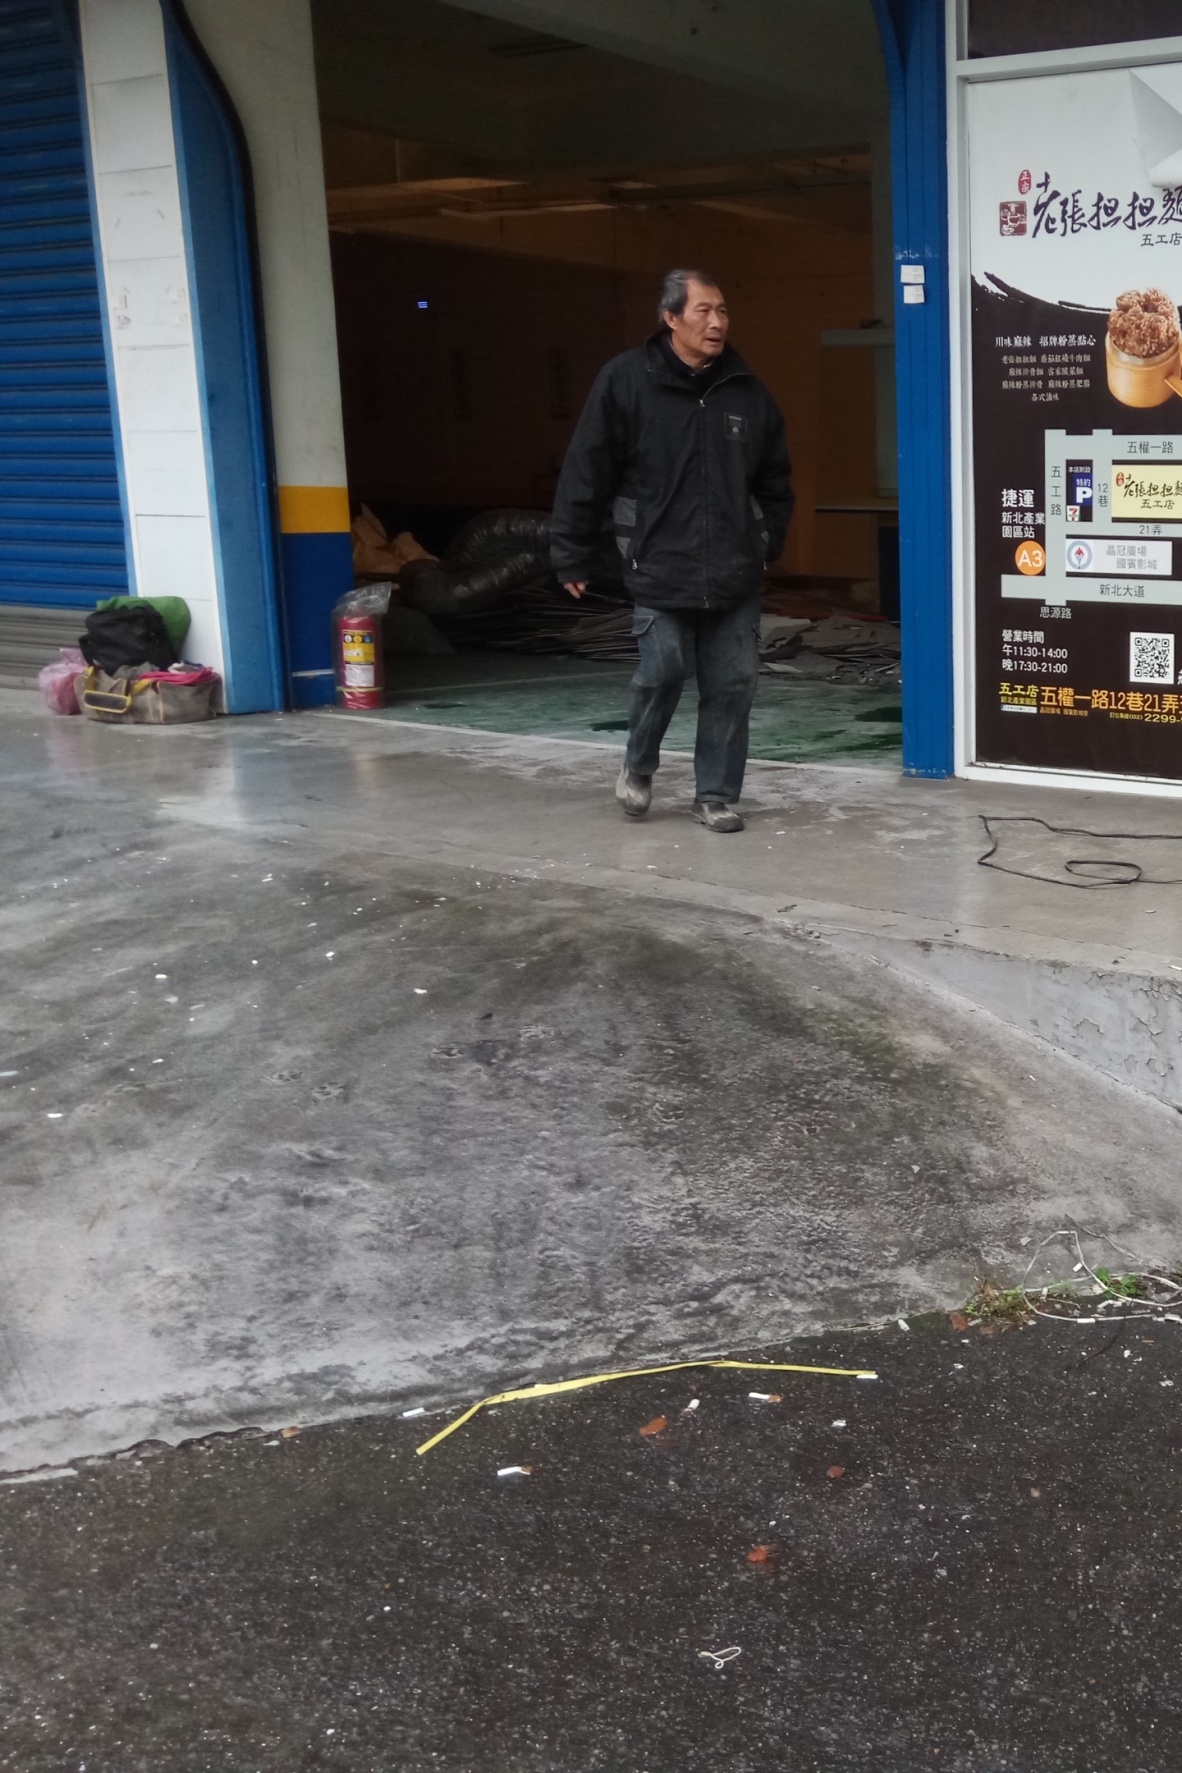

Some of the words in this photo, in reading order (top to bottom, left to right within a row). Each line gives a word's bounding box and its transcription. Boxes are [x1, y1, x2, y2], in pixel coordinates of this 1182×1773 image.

[1141, 232, 1182, 247] 五工店
[995, 335, 1032, 348] 川味麻辣
[1039, 334, 1097, 347] 招牌粉蒸點心
[1127, 441, 1173, 454] 五權一路
[1051, 466, 1061, 515] 五工路
[1076, 487, 1093, 503] P
[1001, 488, 1035, 508] 捷運
[1141, 499, 1175, 509] 五工店
[1001, 511, 1046, 525] 新北產業
[1002, 525, 1035, 538] 園區站
[1106, 545, 1147, 557] 晶冠廣場
[1018, 549, 1043, 568] A3
[1116, 558, 1158, 570] 國賓影城
[1099, 584, 1145, 598] 新北大道
[1040, 606, 1072, 619] 思源路
[1002, 629, 1044, 643] 營業時間
[1002, 644, 1068, 659] 午11:30-14:00
[1002, 658, 1068, 673] 晚17:30-21:00
[999, 682, 1039, 698] 五工店
